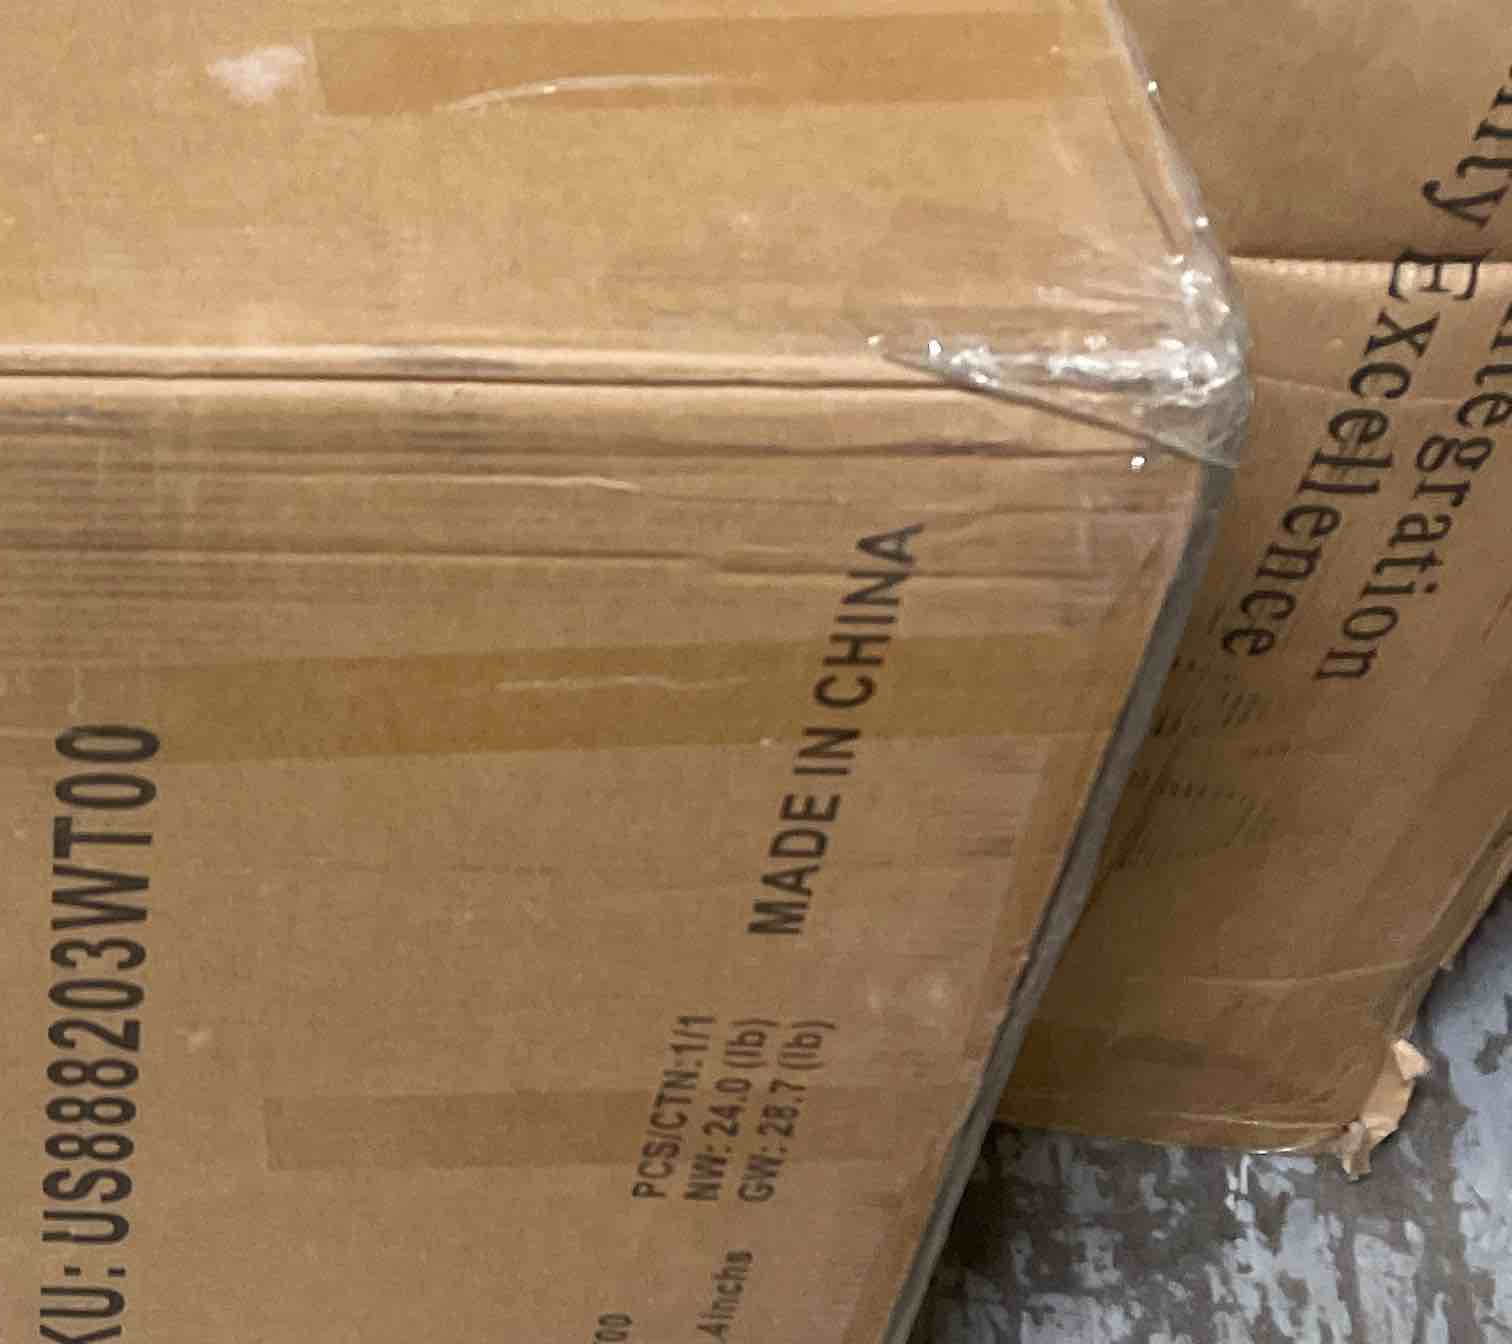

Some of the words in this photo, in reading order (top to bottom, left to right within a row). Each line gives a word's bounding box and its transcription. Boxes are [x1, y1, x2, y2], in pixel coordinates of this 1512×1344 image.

[1221, 246, 1493, 658] Excellence
[1311, 301, 1512, 682] tegration
[812, 522, 926, 709] CHINA
[792, 727, 861, 776] IN
[746, 793, 841, 936] MADE
[722, 1018, 781, 1069] (lb)
[777, 1020, 836, 1070] (lb)
